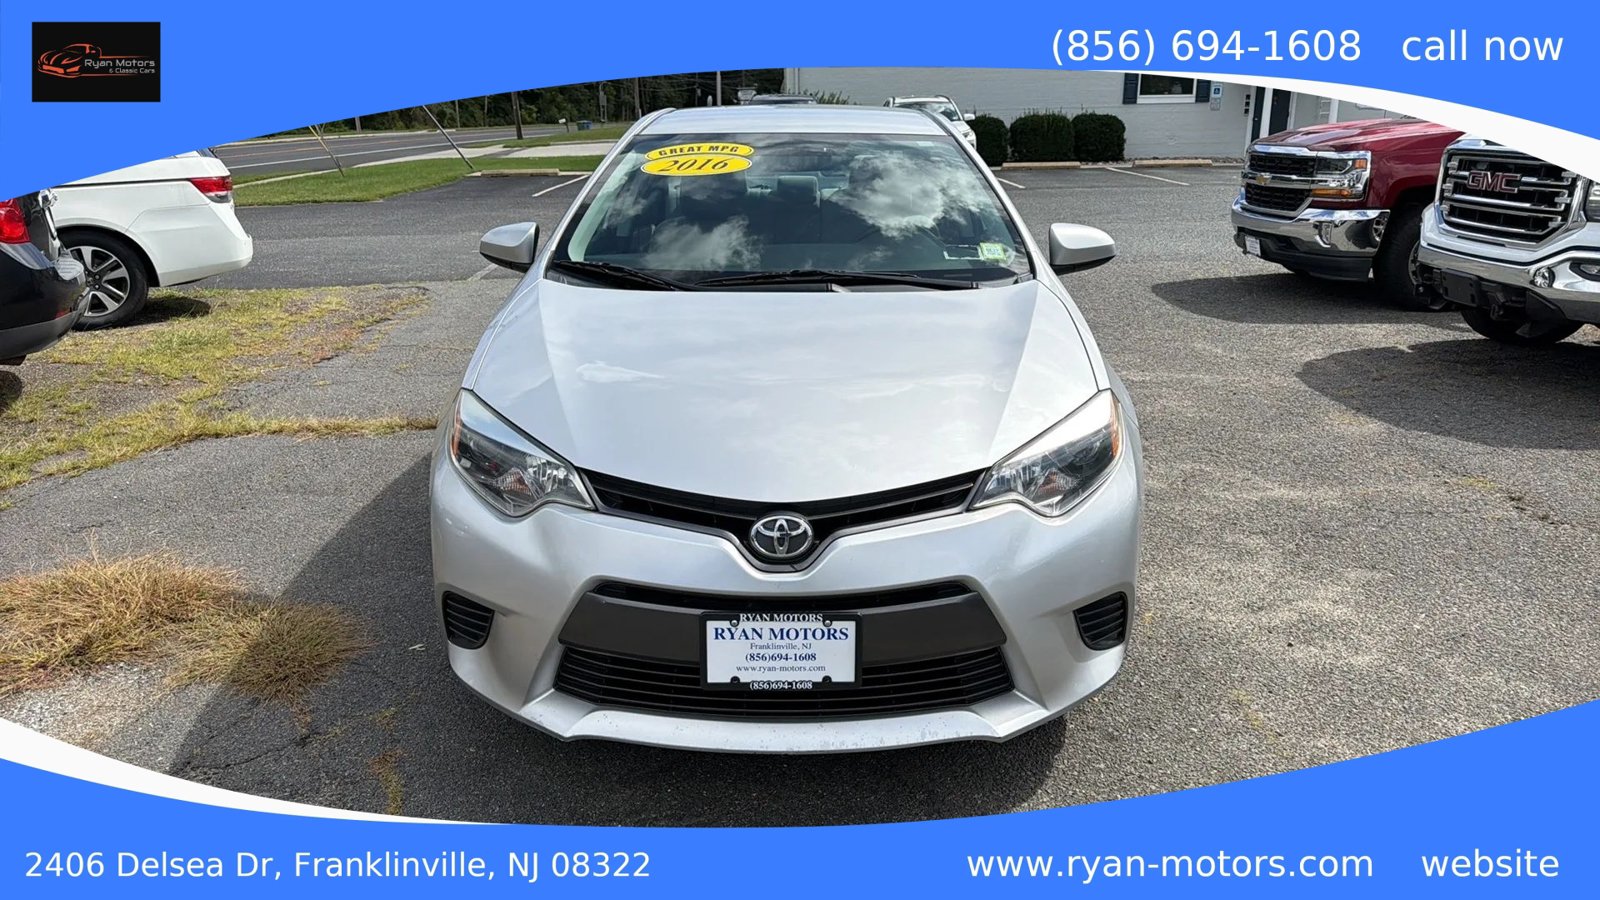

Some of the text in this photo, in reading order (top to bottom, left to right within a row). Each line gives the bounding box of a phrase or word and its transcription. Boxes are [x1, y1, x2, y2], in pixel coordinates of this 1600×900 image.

[658, 145, 739, 156] GREAT MPG
[658, 157, 733, 172] 2016
[1467, 170, 1521, 194] GMC
[739, 613, 823, 623] RYAN MOTORS
[713, 627, 849, 641] RYAN MOTORS
[750, 643, 800, 651] Franklinville,
[745, 652, 817, 662] (856)694-1608
[736, 666, 826, 674] www.ryan-motors.com
[750, 681, 813, 690] (856)694-1608
